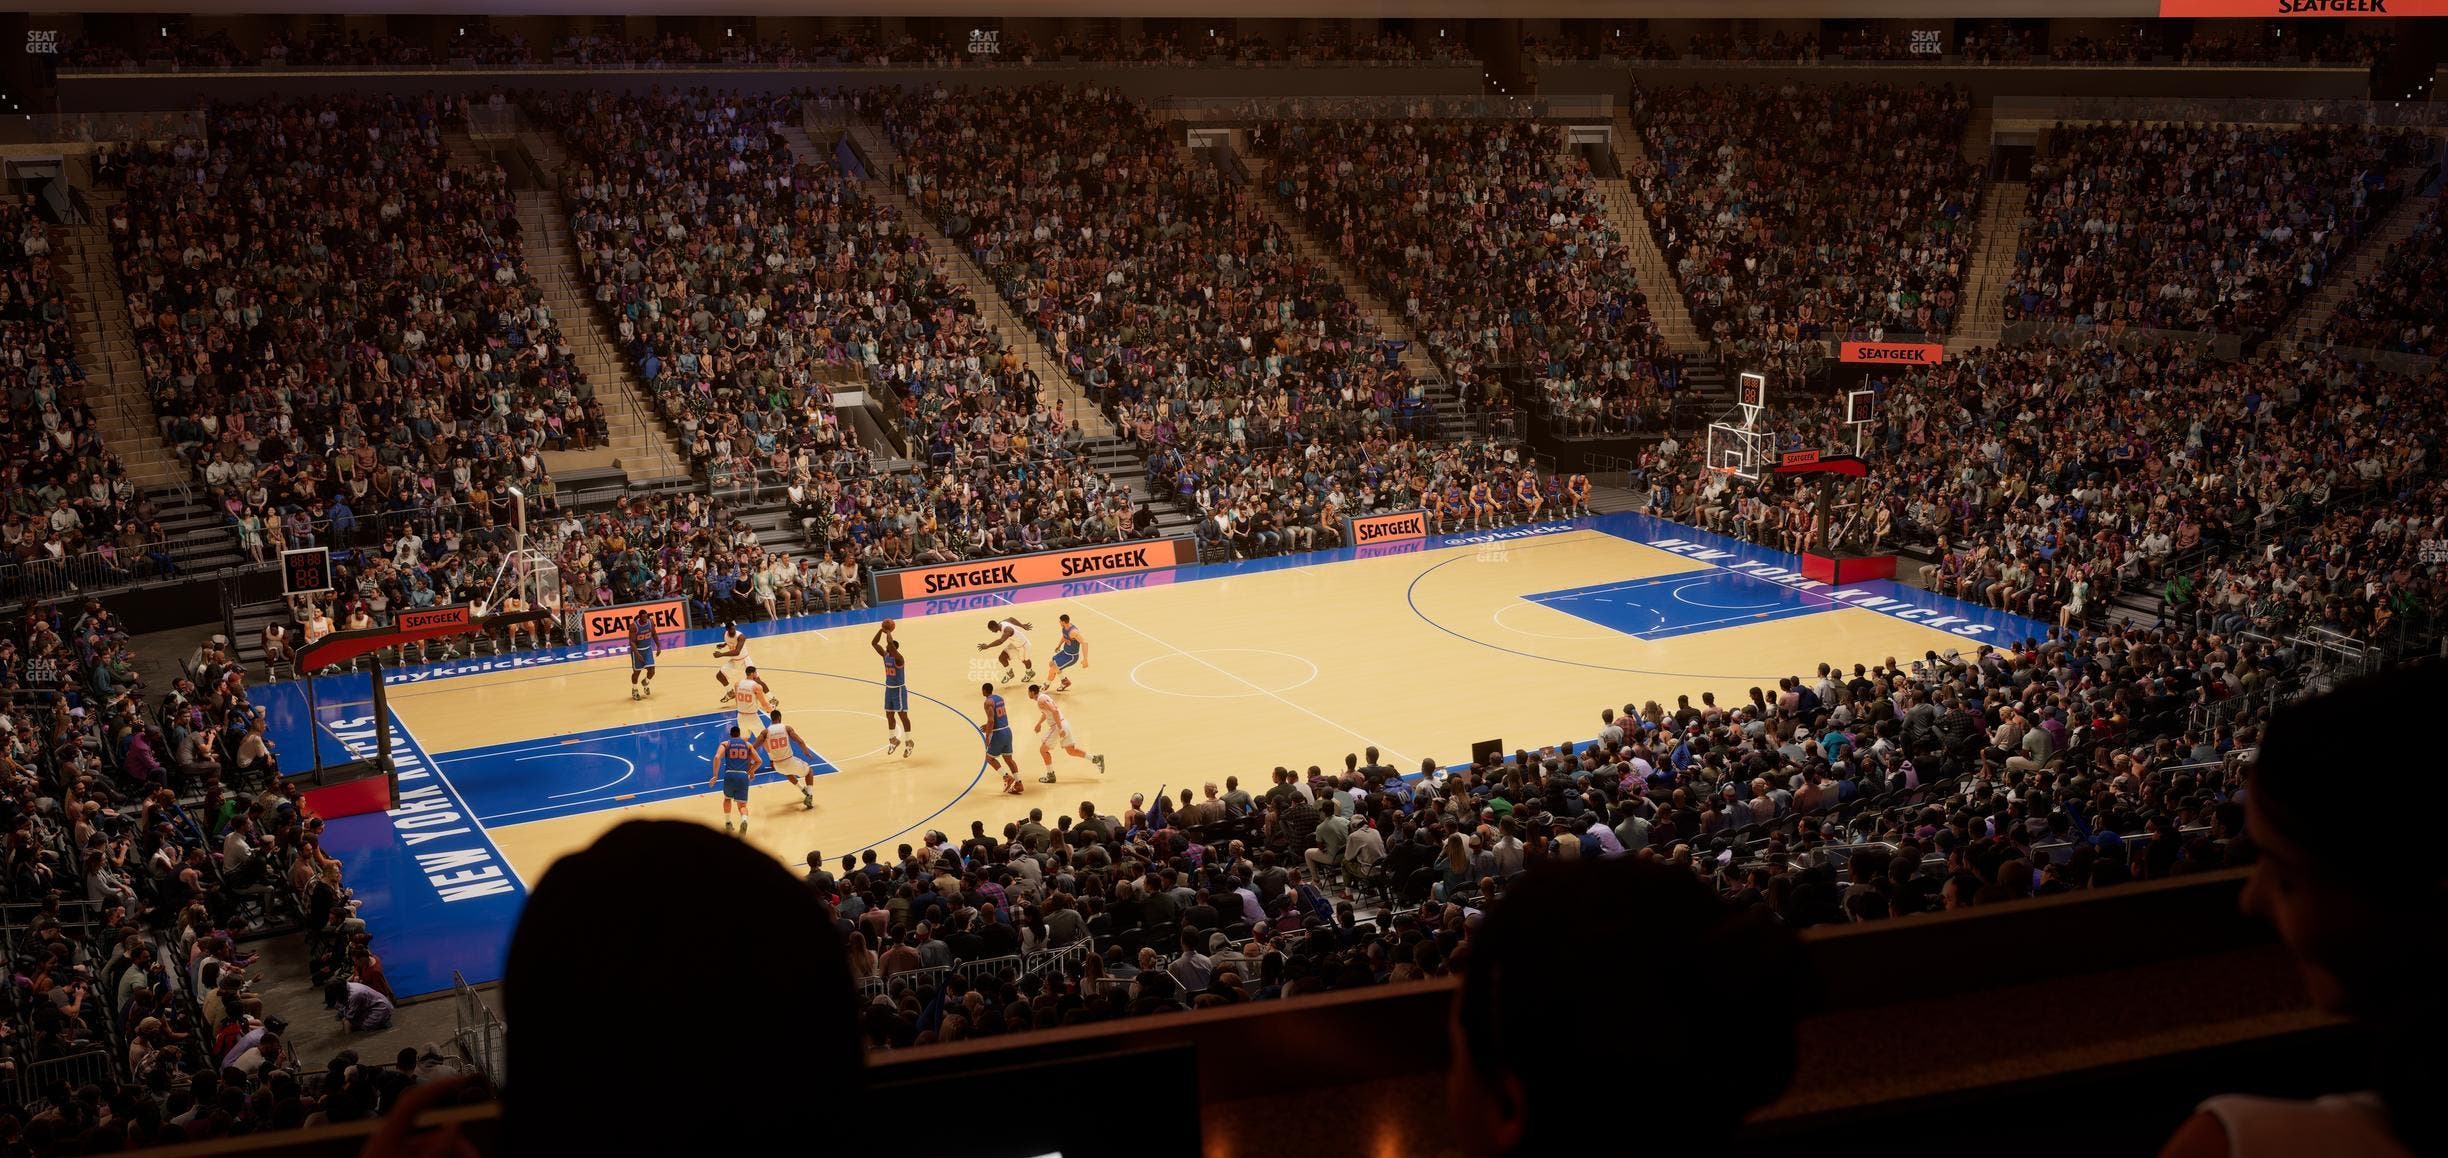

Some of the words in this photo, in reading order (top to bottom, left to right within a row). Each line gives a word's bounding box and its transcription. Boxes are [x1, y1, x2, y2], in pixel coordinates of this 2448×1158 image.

[2278, 0, 2388, 13] SEATGEEK
[1858, 347, 1925, 361] SEATGEEK
[1786, 453, 1815, 464] SEATGEEK
[1359, 518, 1422, 540] SEATGEEK
[1444, 523, 1573, 545] @nyknicks
[1061, 548, 1149, 577] SEATGEEK
[924, 564, 1018, 594] SEATGEEK
[1645, 538, 1737, 560] NEW
[1727, 559, 1829, 590] YORK
[1825, 588, 1996, 636] KNICKS
[406, 609, 462, 628] SEATGEEK
[592, 607, 680, 637] SEATEK
[736, 692, 752, 703] 00
[729, 748, 748, 759] 00
[770, 736, 787, 750] 00
[386, 784, 471, 847] YORK
[415, 847, 515, 903] NEW
